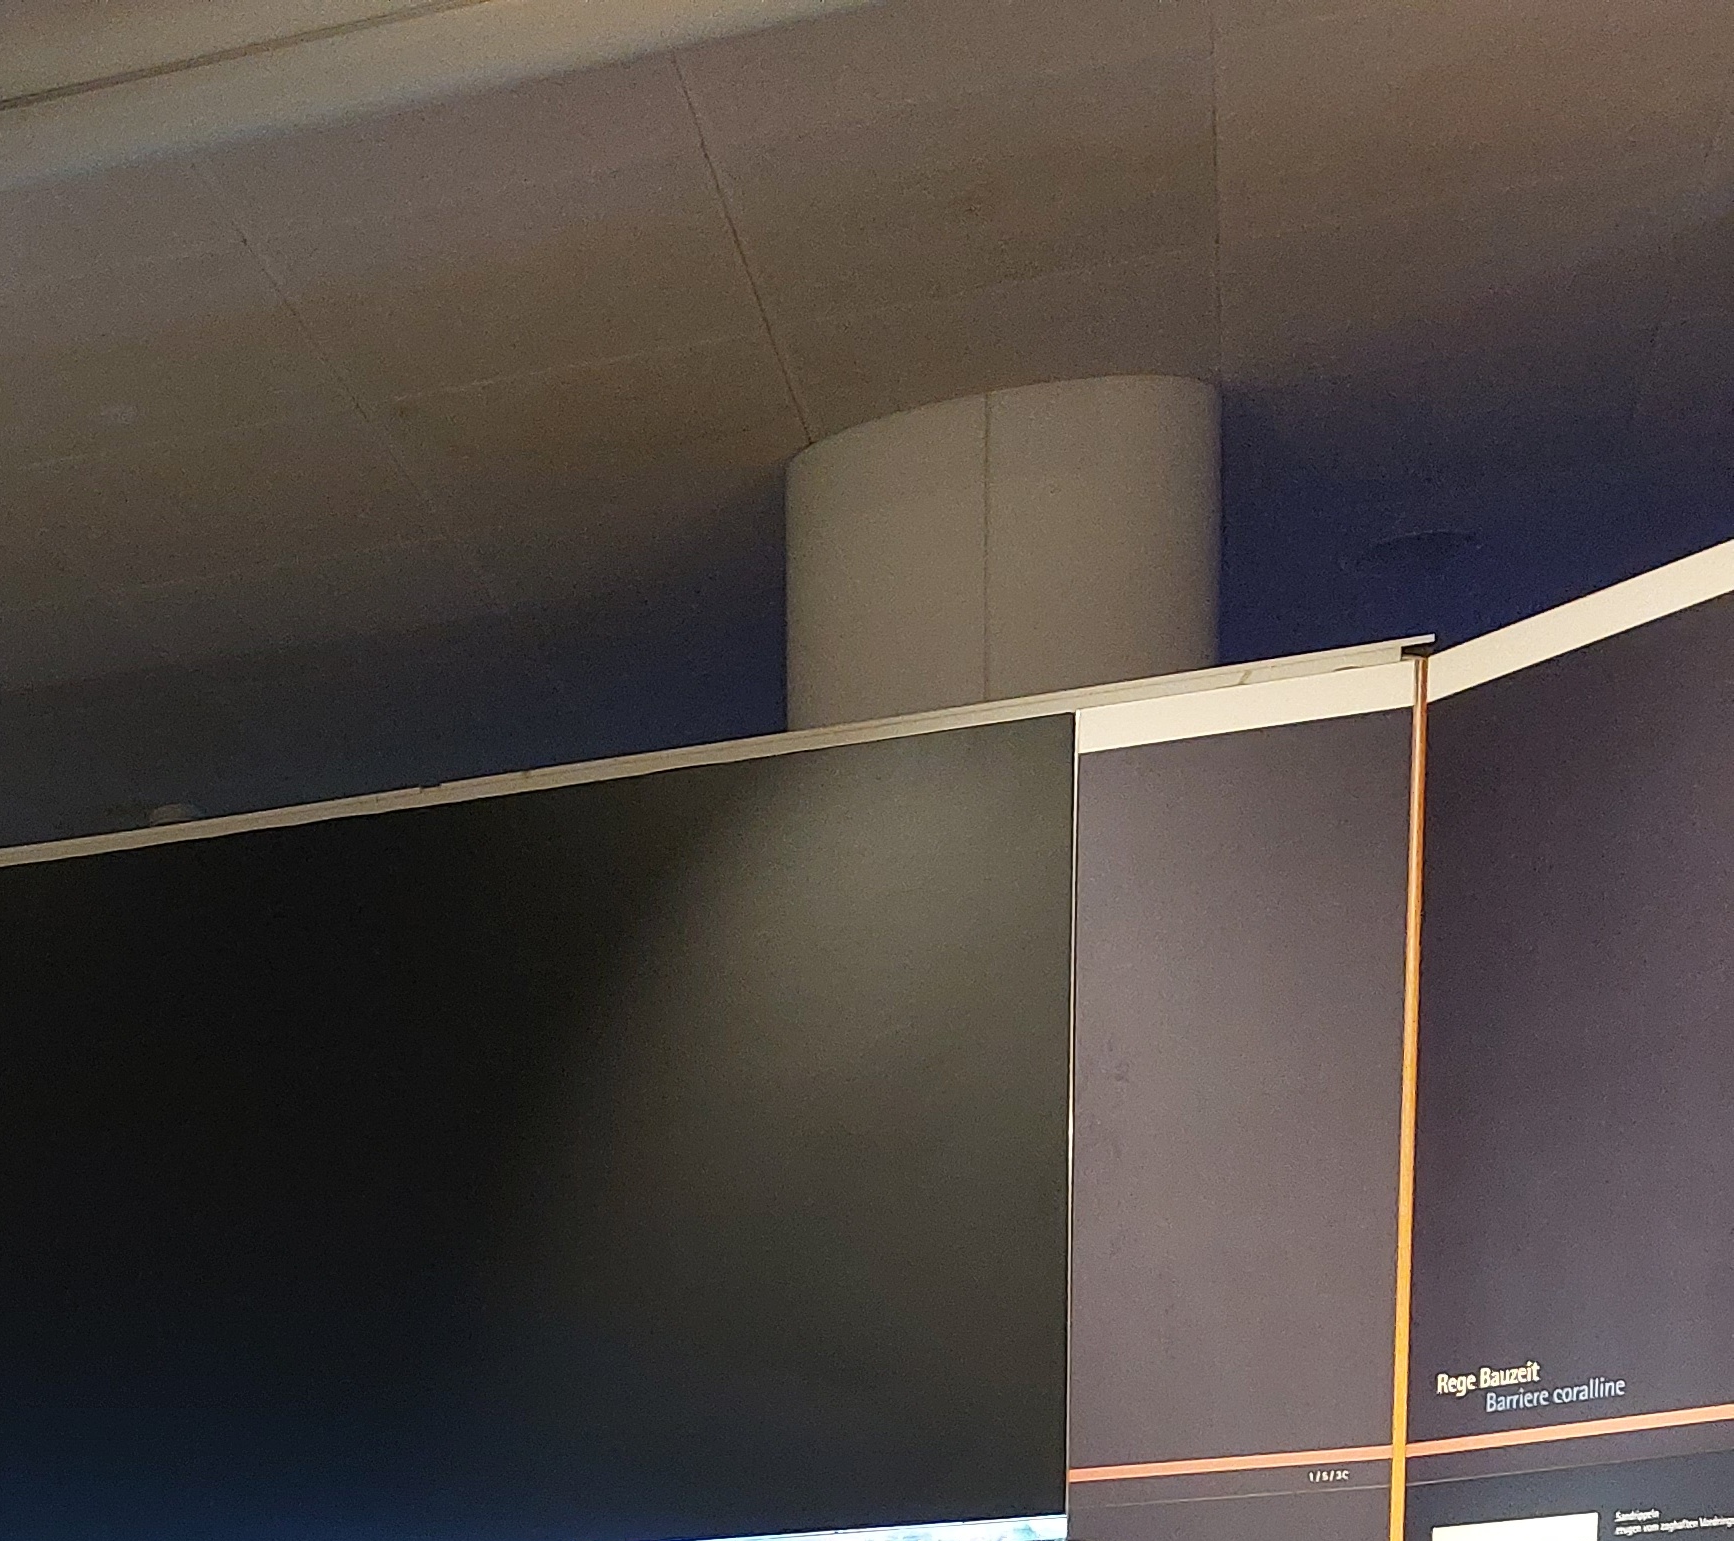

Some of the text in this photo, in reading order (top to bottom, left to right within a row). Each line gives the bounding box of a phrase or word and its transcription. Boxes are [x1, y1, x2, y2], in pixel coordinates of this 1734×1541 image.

[1436, 1360, 1540, 1397] Rege Bauzeit
[1485, 1376, 1626, 1413] Barriere coralline
